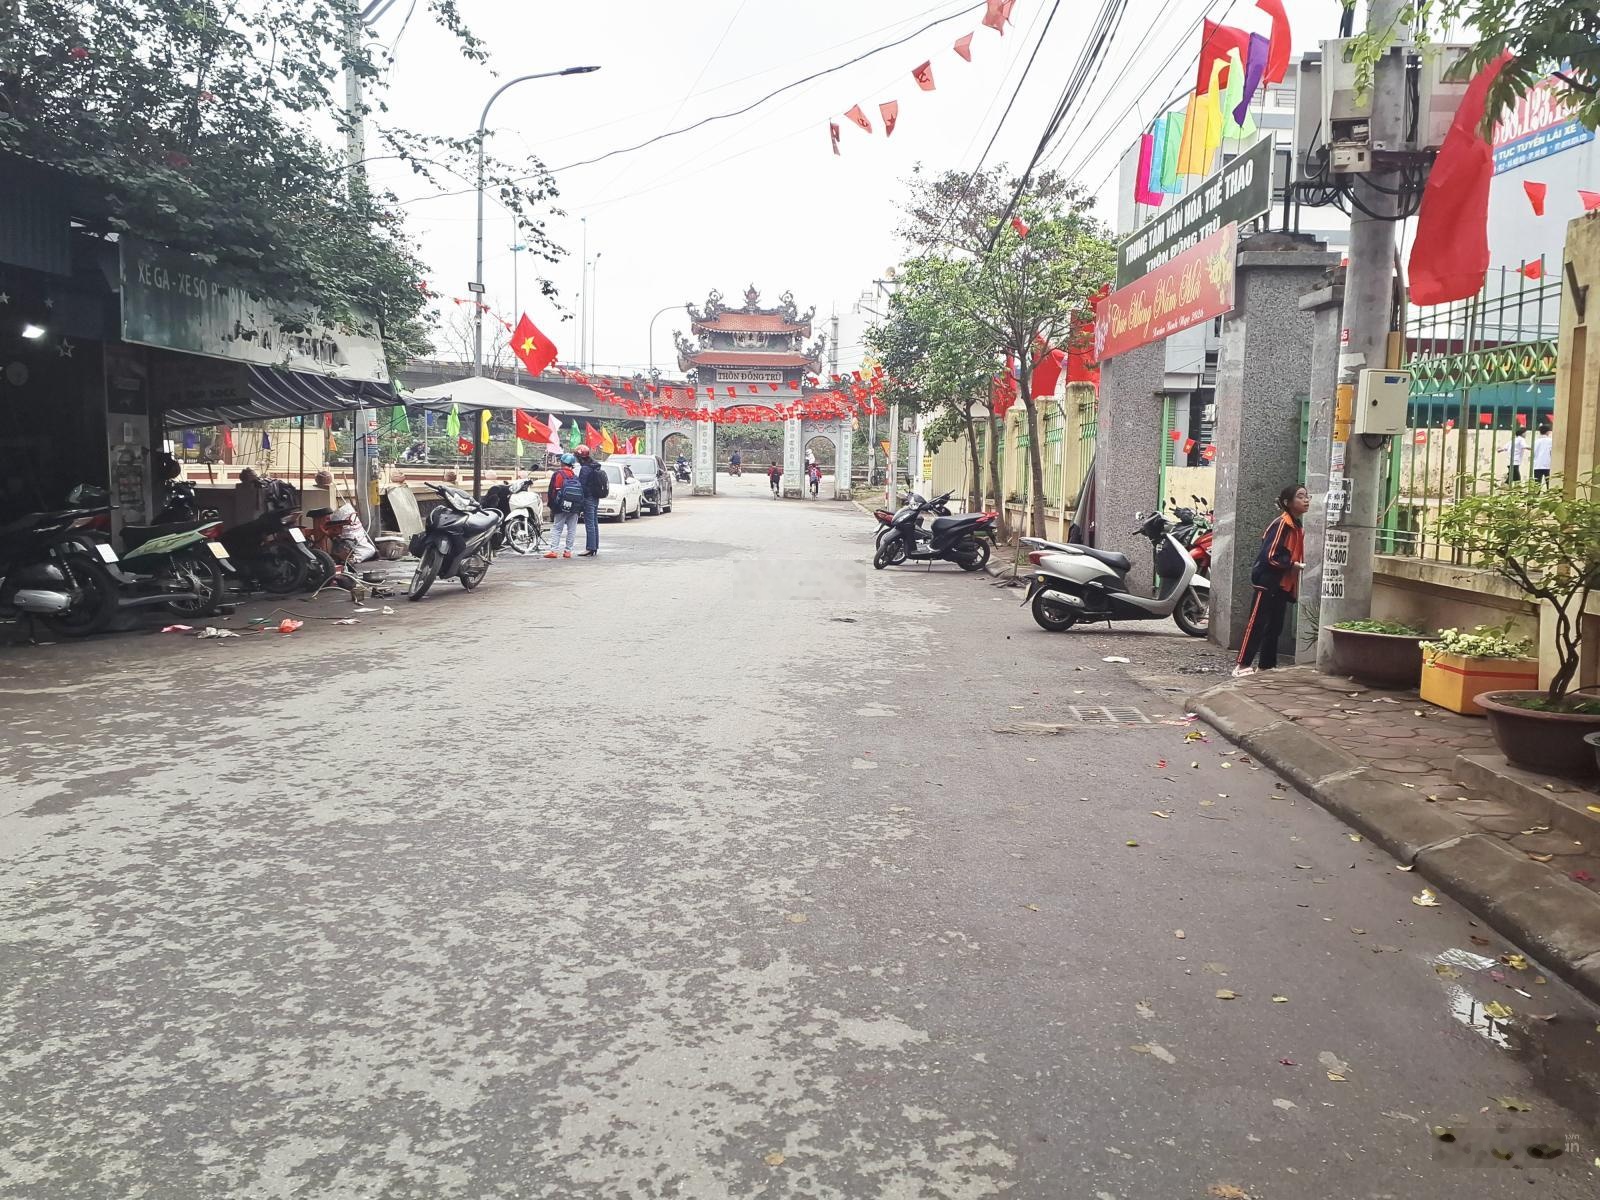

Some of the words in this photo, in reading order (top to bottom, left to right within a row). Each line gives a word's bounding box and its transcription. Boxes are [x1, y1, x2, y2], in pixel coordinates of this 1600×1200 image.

[1547, 129, 1563, 141] LÁI
[1563, 123, 1577, 136] XE
[1126, 234, 1147, 266] TRUNG
[1149, 222, 1165, 251] TÂM
[1167, 208, 1183, 239] VĂN
[1184, 193, 1203, 227] HÓA
[1205, 169, 1223, 214] THỂ
[1225, 159, 1253, 200] THAO
[1146, 249, 1168, 273] THÔN
[138, 260, 152, 286] XE
[154, 267, 170, 290] GA
[179, 272, 192, 297] XE
[1153, 275, 1177, 319] Năm
[718, 371, 740, 380] THÔN
[740, 371, 764, 381] ĐÔNG
[765, 372, 781, 381] TRÙ
